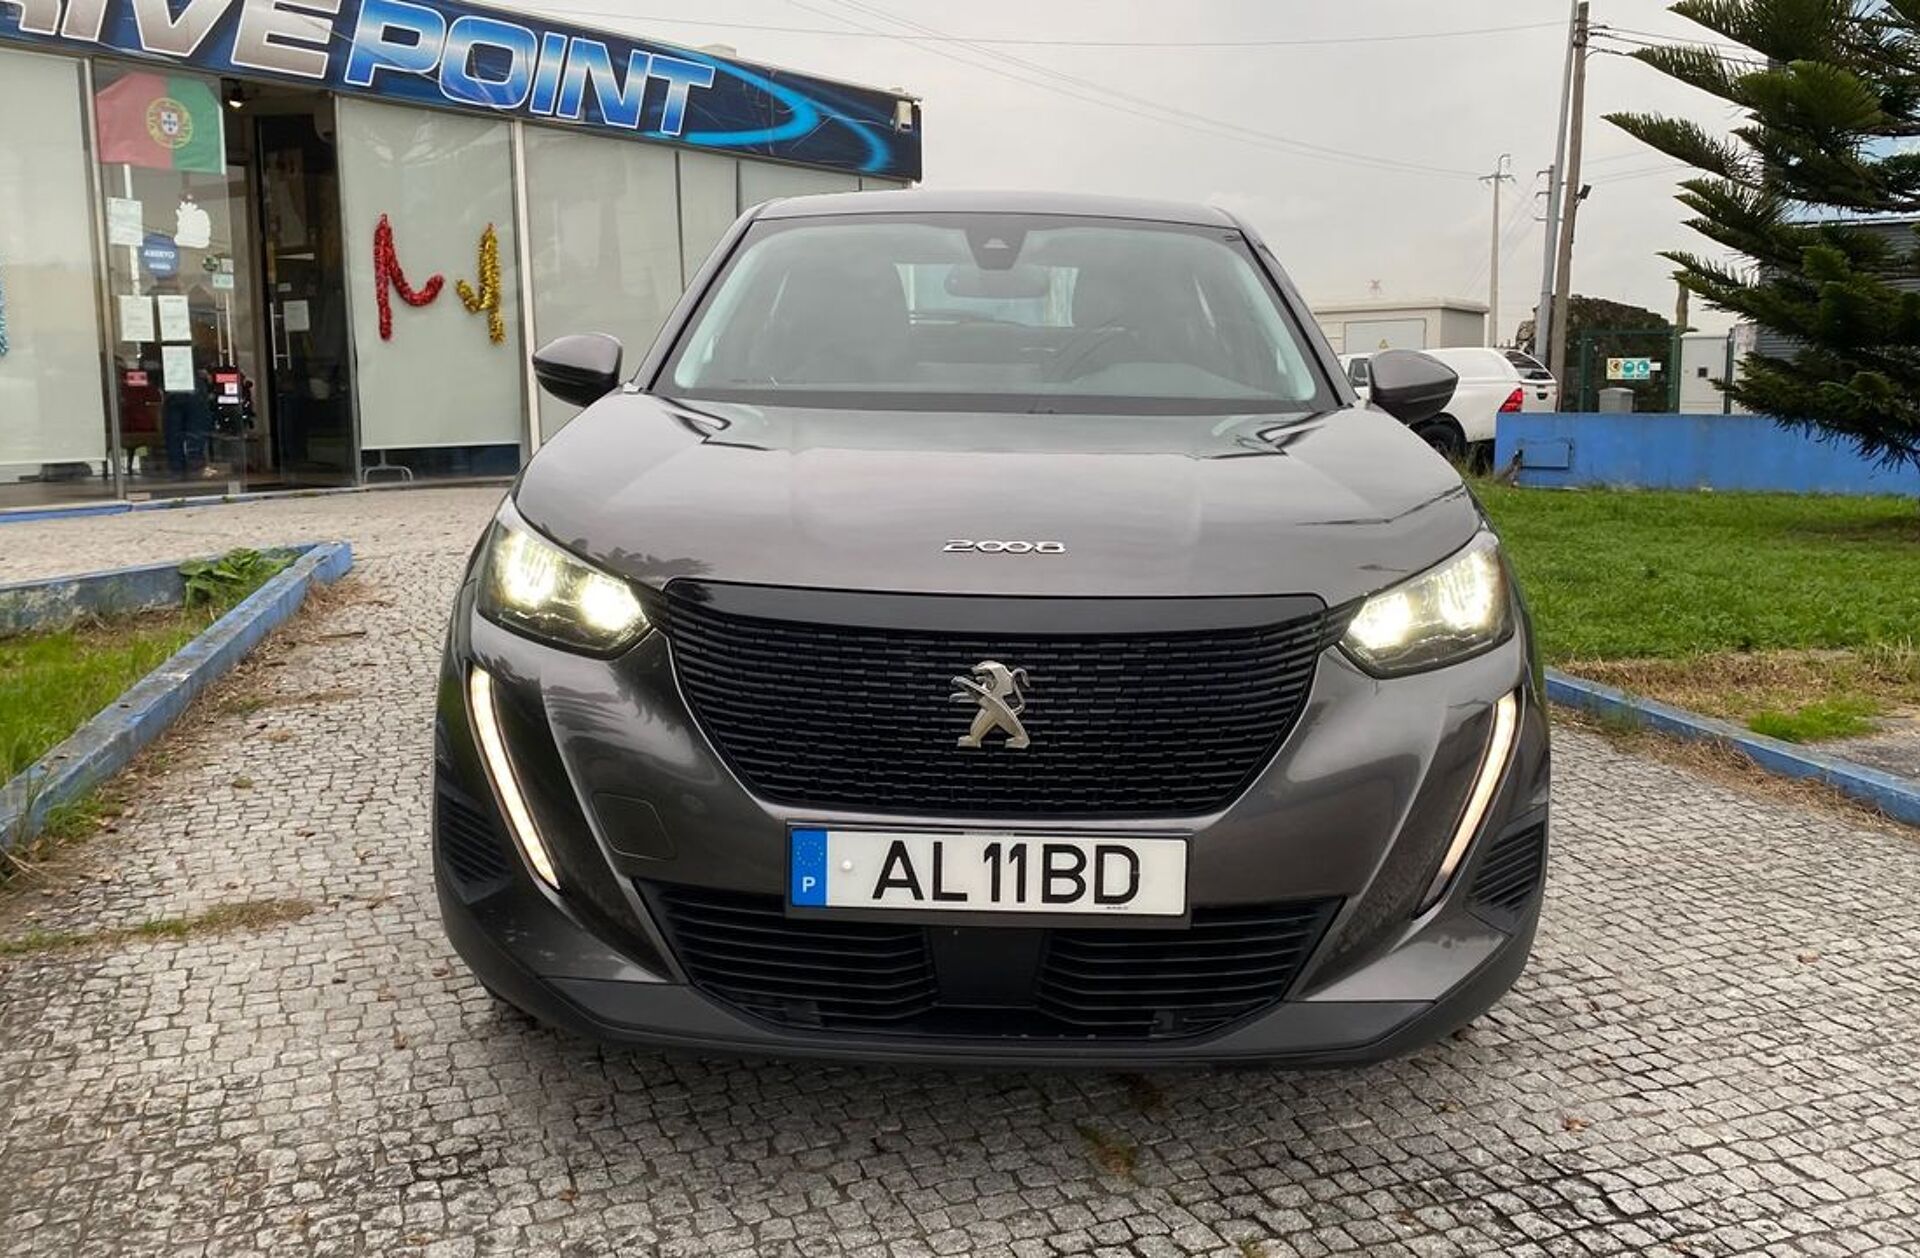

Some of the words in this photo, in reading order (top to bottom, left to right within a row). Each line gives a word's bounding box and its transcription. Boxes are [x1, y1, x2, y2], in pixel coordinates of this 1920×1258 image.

[344, 0, 715, 136] POINT
[943, 539, 1067, 554] 2008
[802, 876, 816, 893] P
